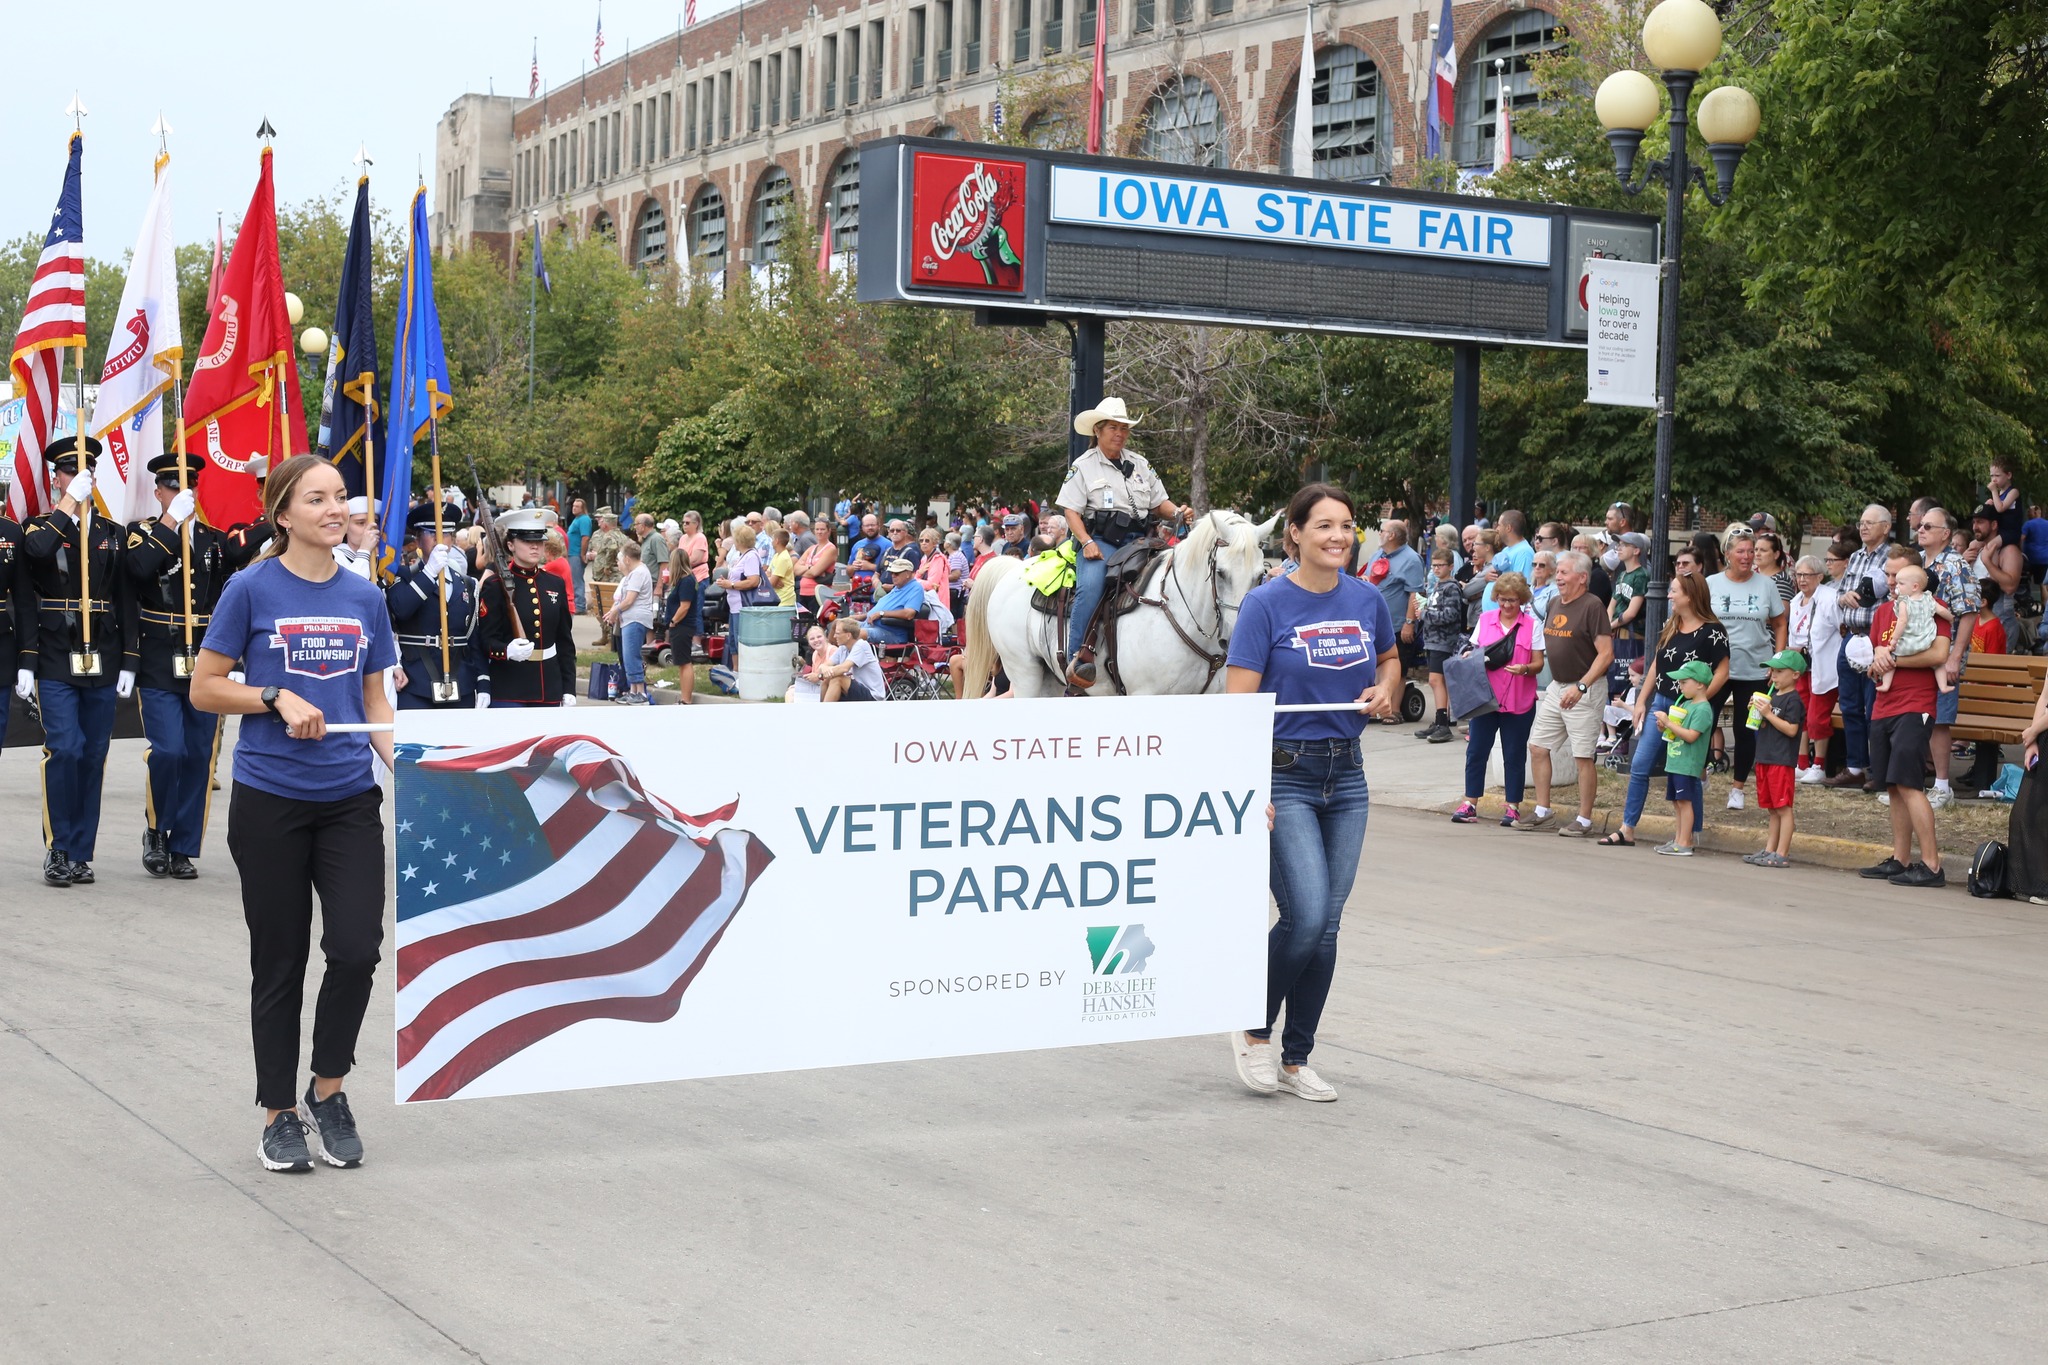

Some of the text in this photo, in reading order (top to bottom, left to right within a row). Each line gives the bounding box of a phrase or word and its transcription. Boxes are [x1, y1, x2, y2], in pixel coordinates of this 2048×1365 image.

[931, 162, 998, 261] Coca-Cola
[1098, 176, 1514, 256] IOWA STATE FAIR
[1587, 238, 1609, 248] ENJOY
[1599, 278, 1618, 288] Google
[1598, 293, 1630, 307] Helping
[1598, 305, 1640, 319] Iowa grow
[1599, 317, 1637, 330] for over a
[1598, 329, 1629, 341] decade
[207, 419, 247, 472] INE CORPS
[111, 440, 131, 477] ARM
[1558, 630, 1573, 638] OAK
[301, 637, 344, 648] FOOD AND
[1318, 638, 1336, 648] FOOD
[292, 649, 354, 661] FELLOWSHIP
[1312, 645, 1362, 657] FELLOWSHIP
[894, 735, 1163, 763] IOWA STATE FAIR
[795, 789, 1256, 854] VETERANS DAY
[909, 858, 1157, 917] PARADE
[889, 970, 1066, 998] SPONSORED BY
[1082, 993, 1156, 1013] HANSEN
[1081, 1011, 1156, 1023] FOUNDATION
